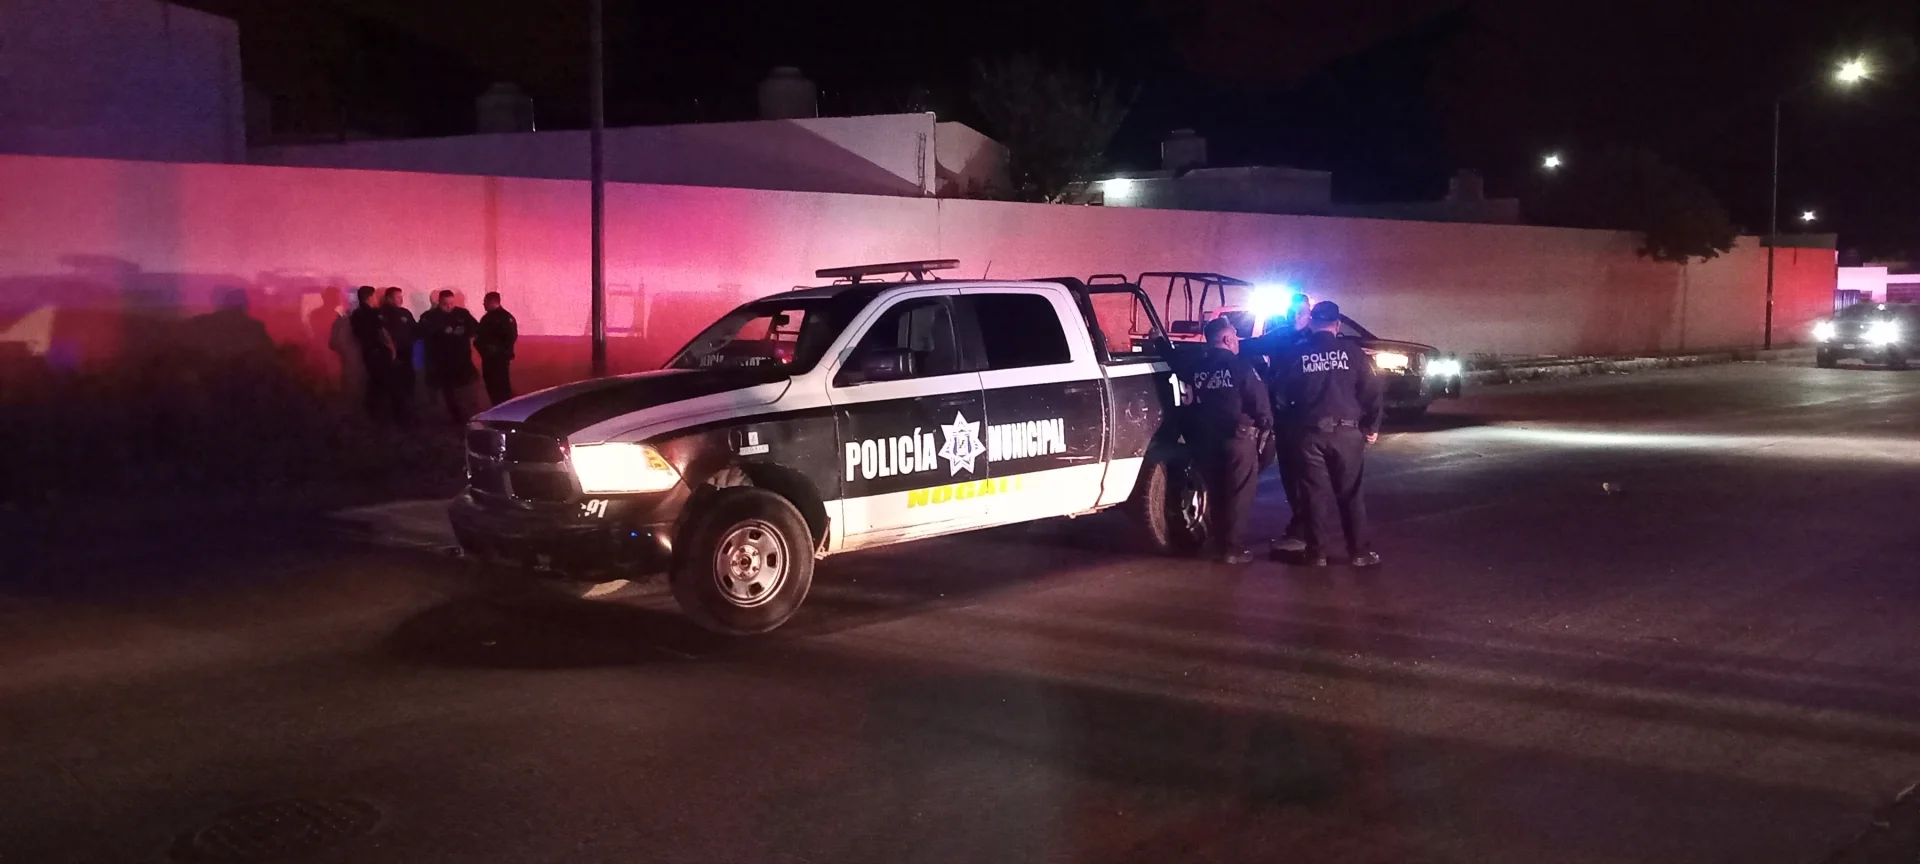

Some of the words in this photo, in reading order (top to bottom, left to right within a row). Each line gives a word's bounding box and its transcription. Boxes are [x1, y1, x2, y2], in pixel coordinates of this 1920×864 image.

[1303, 361, 1349, 373] MUNICIPAL
[845, 427, 938, 482] POLICÍA
[988, 418, 1066, 462] MUNICIPAL
